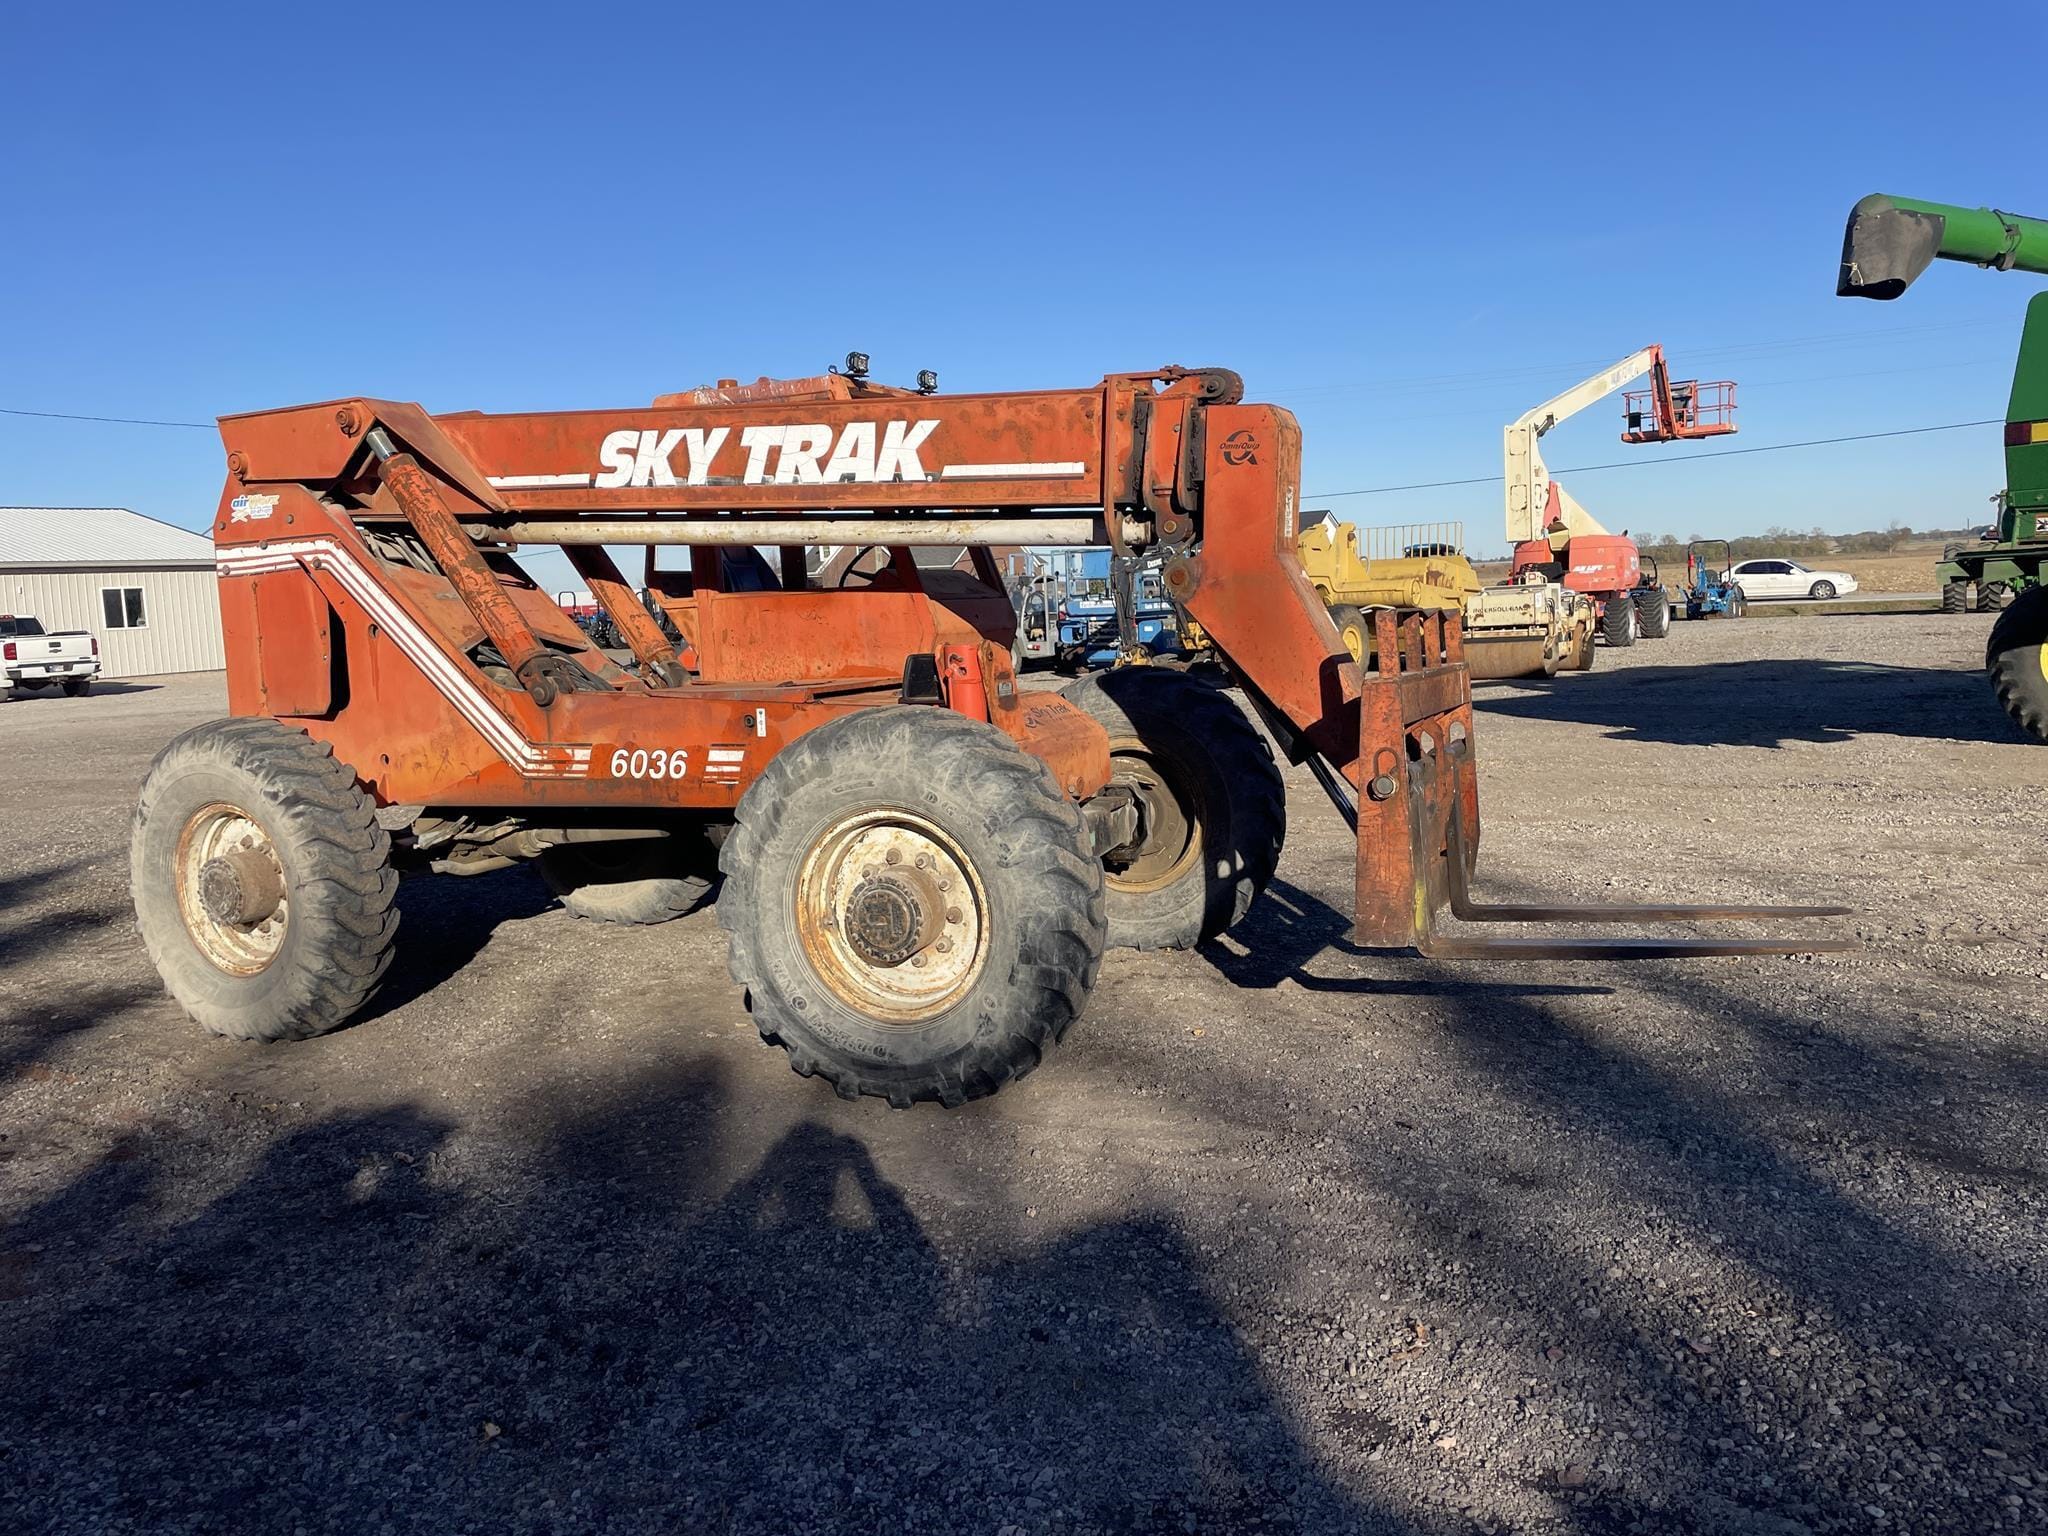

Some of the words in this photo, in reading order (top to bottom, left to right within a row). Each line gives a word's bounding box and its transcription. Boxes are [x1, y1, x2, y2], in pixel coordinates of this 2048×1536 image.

[594, 427, 731, 488] SKY
[740, 420, 942, 486] TRAK
[609, 748, 689, 780] 6036
